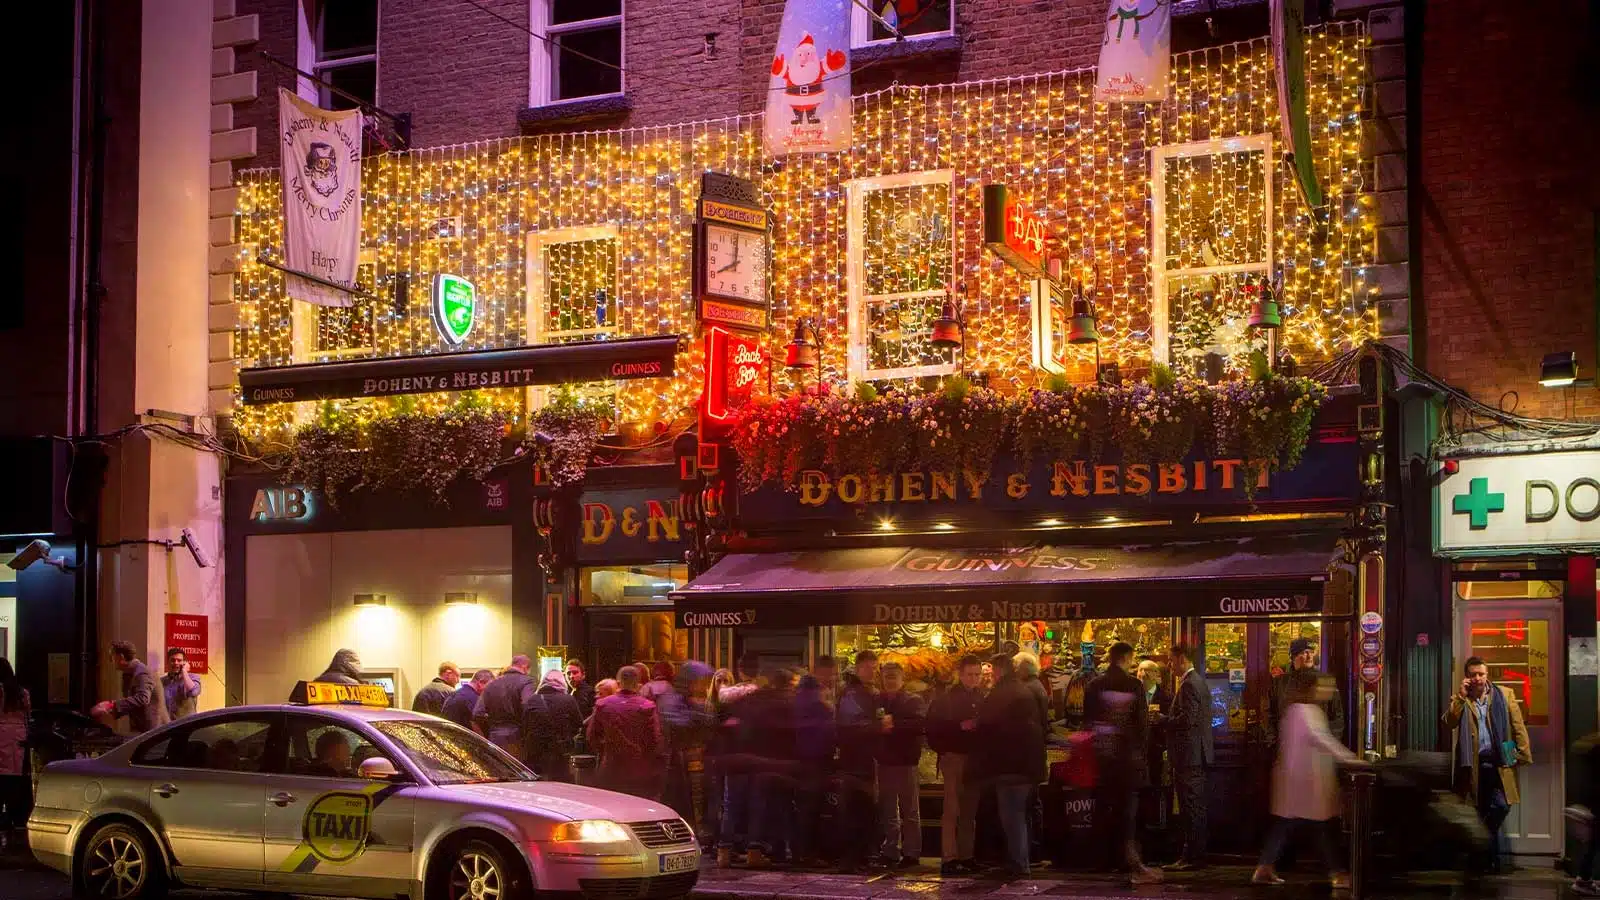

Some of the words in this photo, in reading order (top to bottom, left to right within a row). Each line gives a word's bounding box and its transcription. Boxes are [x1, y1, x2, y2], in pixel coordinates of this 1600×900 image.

[284, 116, 315, 147] Dheny
[319, 117, 329, 132] &
[334, 121, 361, 163] Nesitt
[290, 175, 318, 218] Merry
[319, 188, 357, 222] Chrimas
[1014, 202, 1044, 257] BAR
[710, 255, 716, 265] 9
[710, 270, 716, 279] 8
[731, 283, 737, 292] 6
[734, 344, 763, 364] Back
[613, 361, 661, 376] GUINNESS
[736, 365, 759, 387] Bar
[363, 375, 436, 395] DOHENY
[439, 376, 449, 389] &
[453, 368, 534, 388] NESBITT
[253, 387, 294, 401] GUINNESS
[800, 469, 992, 506] DOHENY
[1007, 473, 1031, 500] &
[1050, 457, 1280, 497] NESBITT
[249, 486, 310, 521] AIB
[487, 497, 503, 507] AIB
[1525, 477, 1600, 523] DO
[582, 502, 616, 545] D
[621, 506, 642, 537] &
[645, 500, 681, 542] N
[906, 555, 1101, 572] GUINNESS
[874, 603, 964, 623] DOHENY
[967, 605, 984, 621] &
[992, 600, 1087, 620] NESBITT
[1219, 597, 1291, 614] GUINNESS
[175, 619, 199, 627] PRIVATE
[683, 611, 742, 627] GUINNESS
[172, 633, 201, 641] PROPERTY
[334, 684, 361, 702] TAXI
[1064, 799, 1097, 815] POW
[313, 812, 362, 840] TAXI
